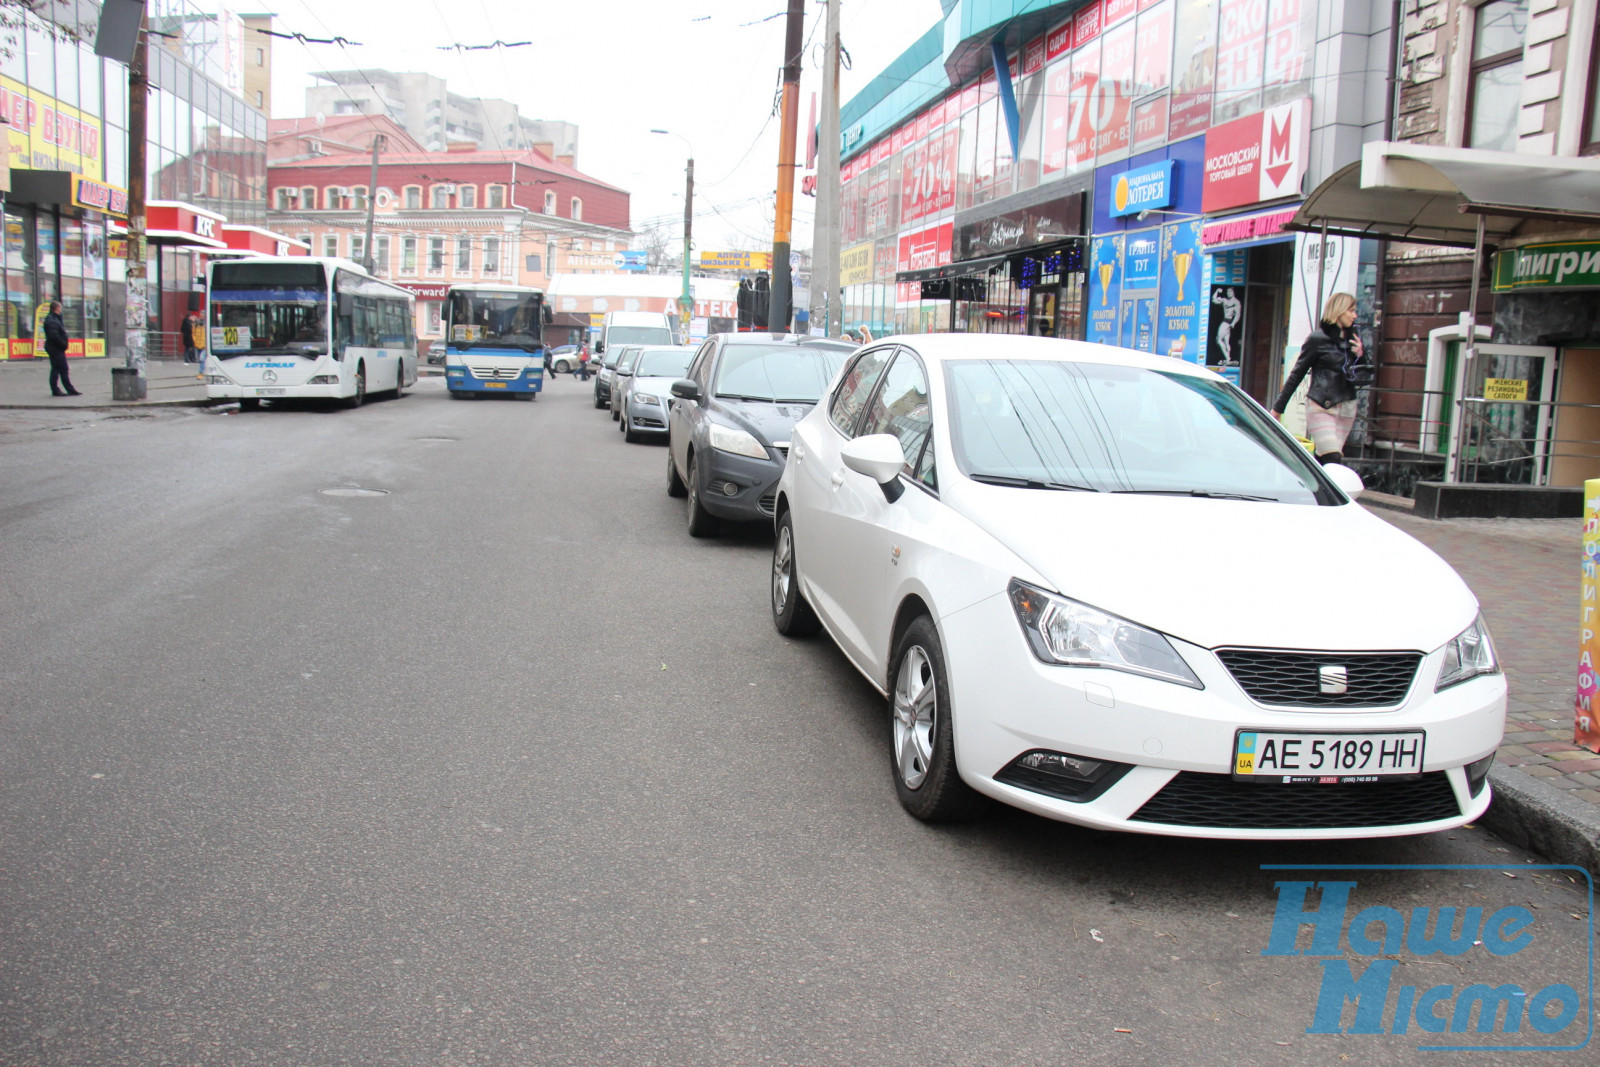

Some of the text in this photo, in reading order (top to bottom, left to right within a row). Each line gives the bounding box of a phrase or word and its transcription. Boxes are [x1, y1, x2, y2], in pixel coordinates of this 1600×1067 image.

[1049, 31, 1068, 52] ОДЯГ
[43, 103, 99, 161] ВЗУТТЯ
[1206, 142, 1260, 172] МОСКОВСКИЙ
[1209, 162, 1254, 183] ТОРГОВЫЙ ЦЕНТР
[1127, 181, 1164, 206] ЛОТЕРЕЯ
[196, 215, 216, 238] KFC
[1308, 241, 1336, 260] МЕТО
[1135, 259, 1149, 272] ТУТ
[664, 299, 738, 318] АТЕК
[1092, 305, 1116, 320] ЗОЛОТИЙ
[1164, 301, 1196, 317] ЗОЛОТИЙ
[1095, 321, 1112, 332] КУБОК
[1168, 318, 1190, 330] КУБОК
[224, 327, 239, 345] 120
[1488, 386, 1525, 394] РЕЗИНОВЫЕ
[1494, 379, 1522, 387] ЖЕНСКИЕ
[1578, 518, 1598, 733] ПОЛИГРАФИЯ
[1258, 738, 1418, 769] AE 5189 HH
[1239, 759, 1253, 769] UA
